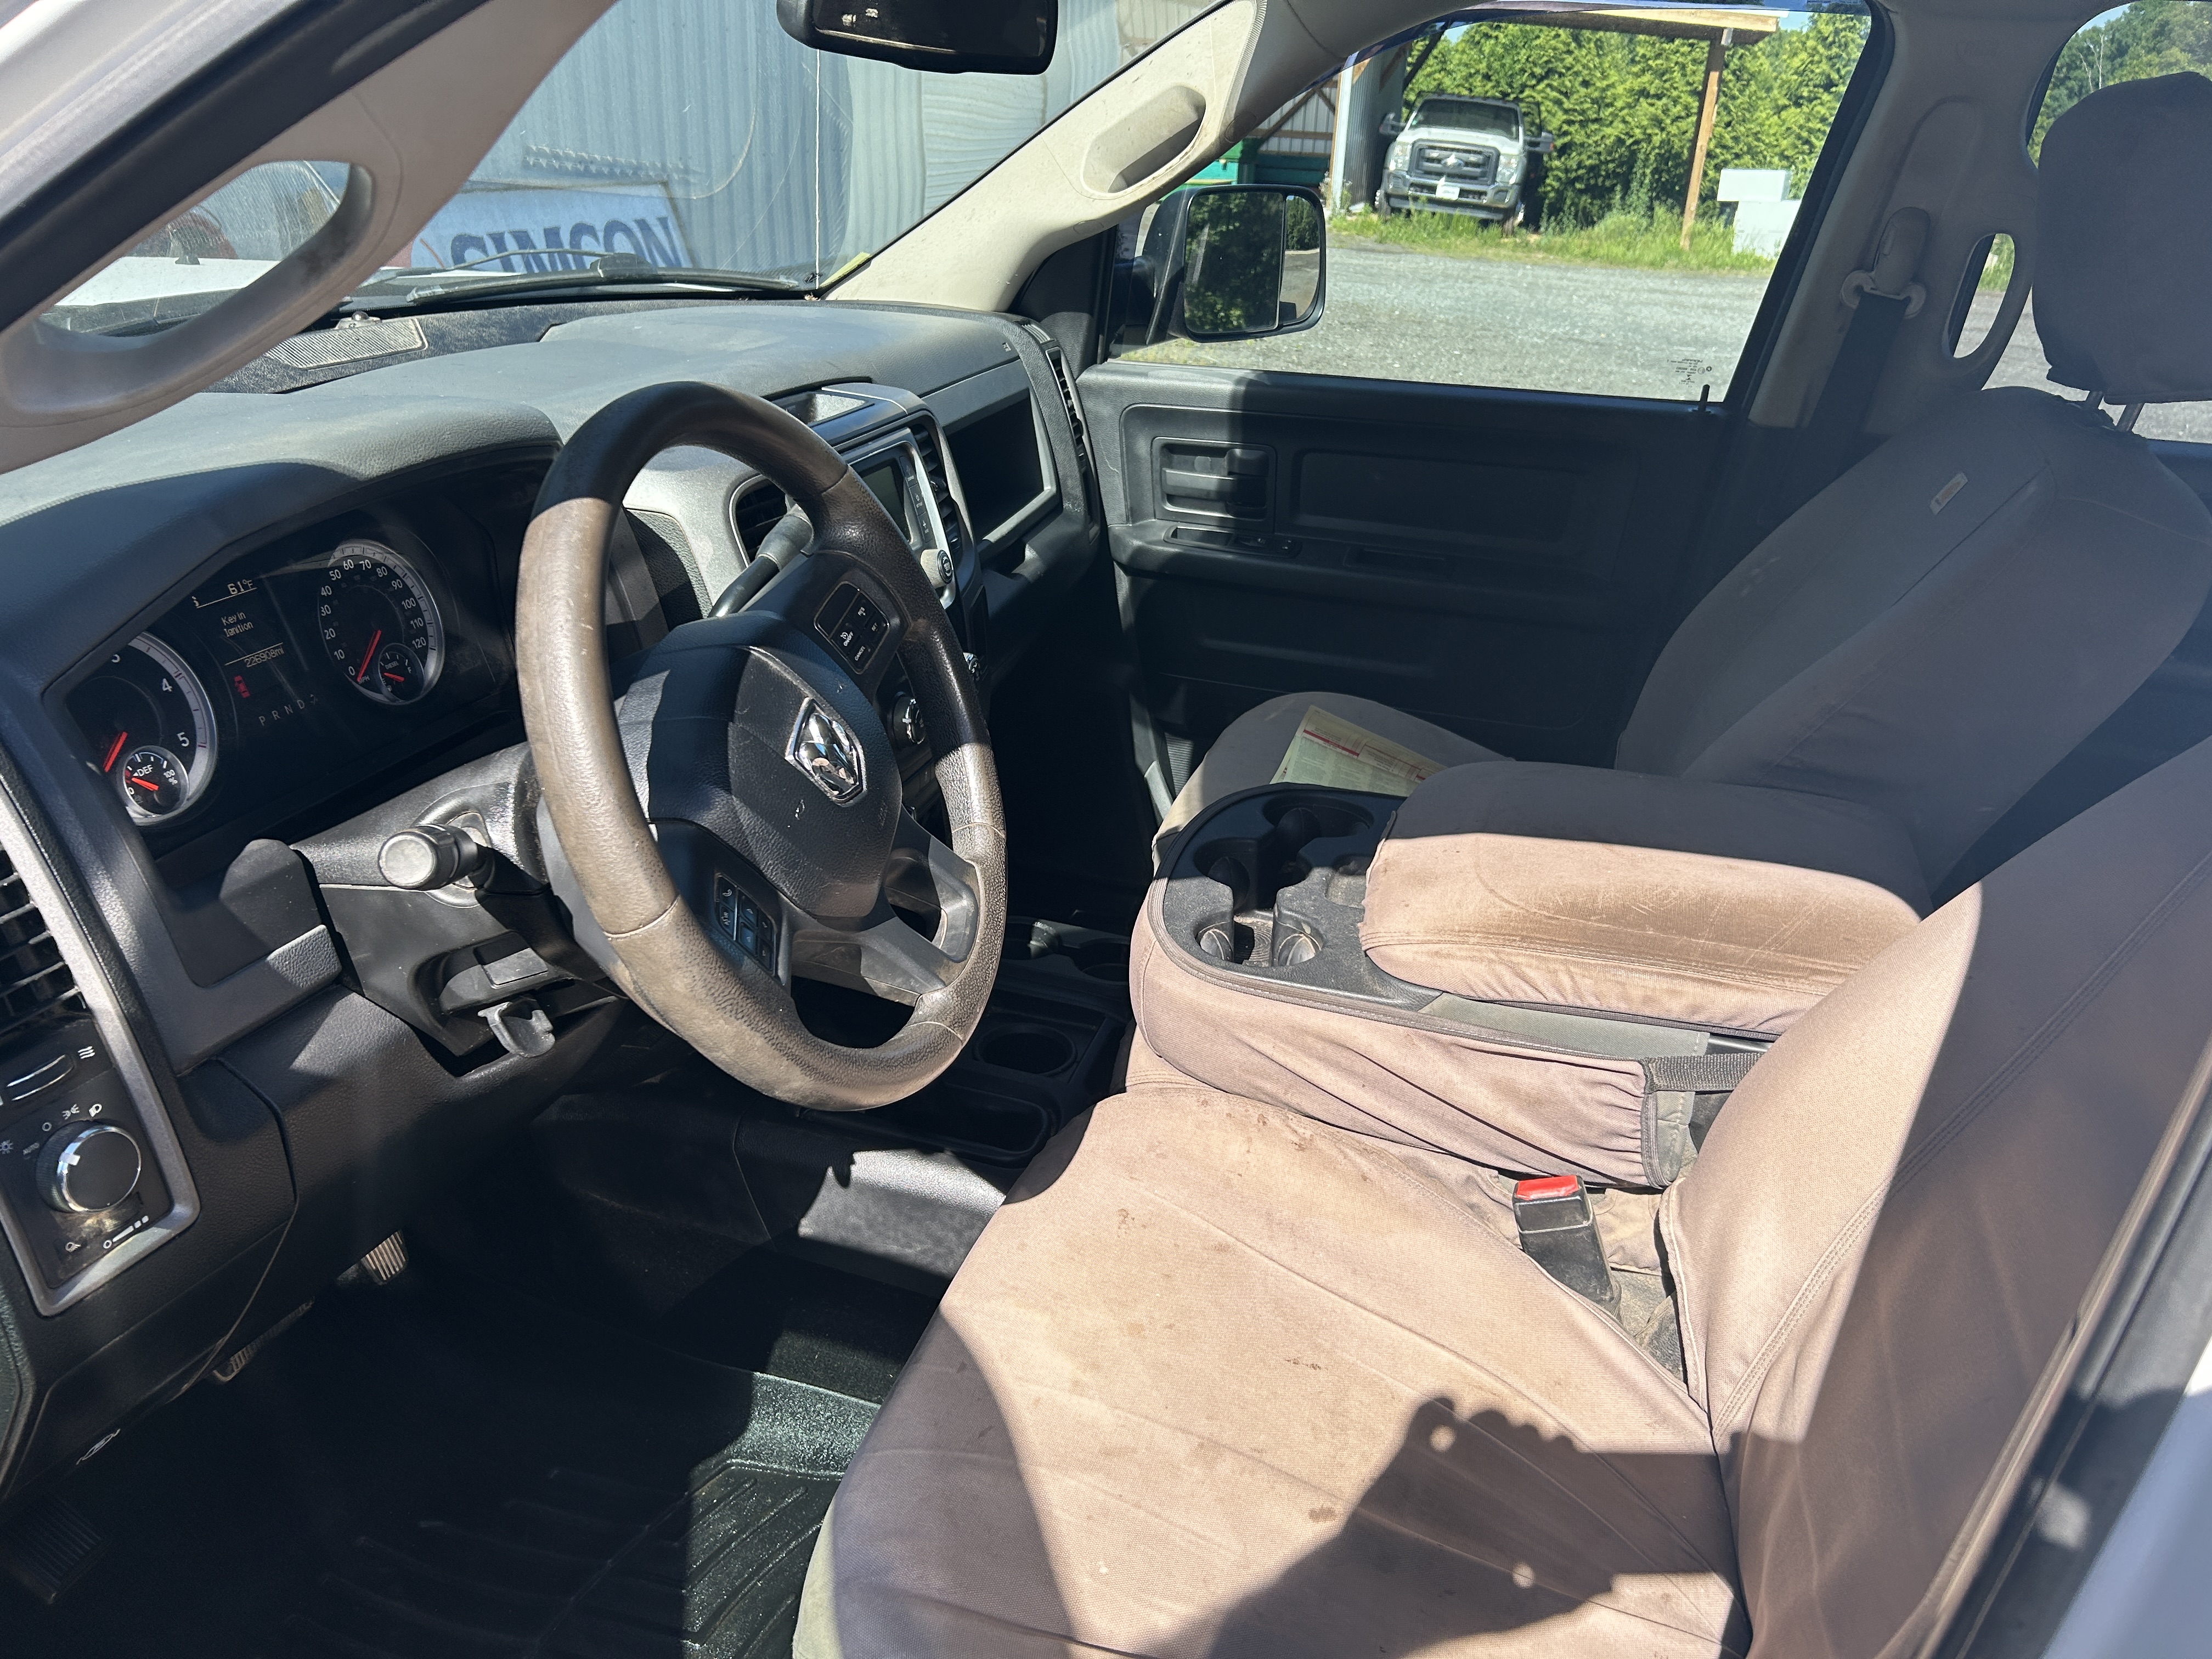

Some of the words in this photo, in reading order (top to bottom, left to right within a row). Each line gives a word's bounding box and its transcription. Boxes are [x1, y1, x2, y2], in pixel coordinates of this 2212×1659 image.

[343, 559, 354, 571] 60
[359, 559, 371, 571] 70
[329, 569, 341, 580] 50
[376, 566, 388, 578] 80
[320, 585, 332, 596] 40
[391, 579, 403, 590] 90
[402, 597, 416, 610] 100
[320, 605, 331, 616] 30
[221, 614, 237, 625] Key
[410, 618, 424, 629] 110
[324, 628, 336, 640] 20
[412, 637, 426, 649] 120
[334, 649, 345, 660] 10
[348, 665, 356, 676] 0
[162, 678, 173, 692] 4
[258, 716, 266, 726] P
[272, 710, 281, 720] R
[284, 704, 294, 715] N
[297, 699, 305, 709] D
[177, 731, 190, 747] 5
[136, 764, 154, 777] DEF
[162, 769, 176, 778] 100
